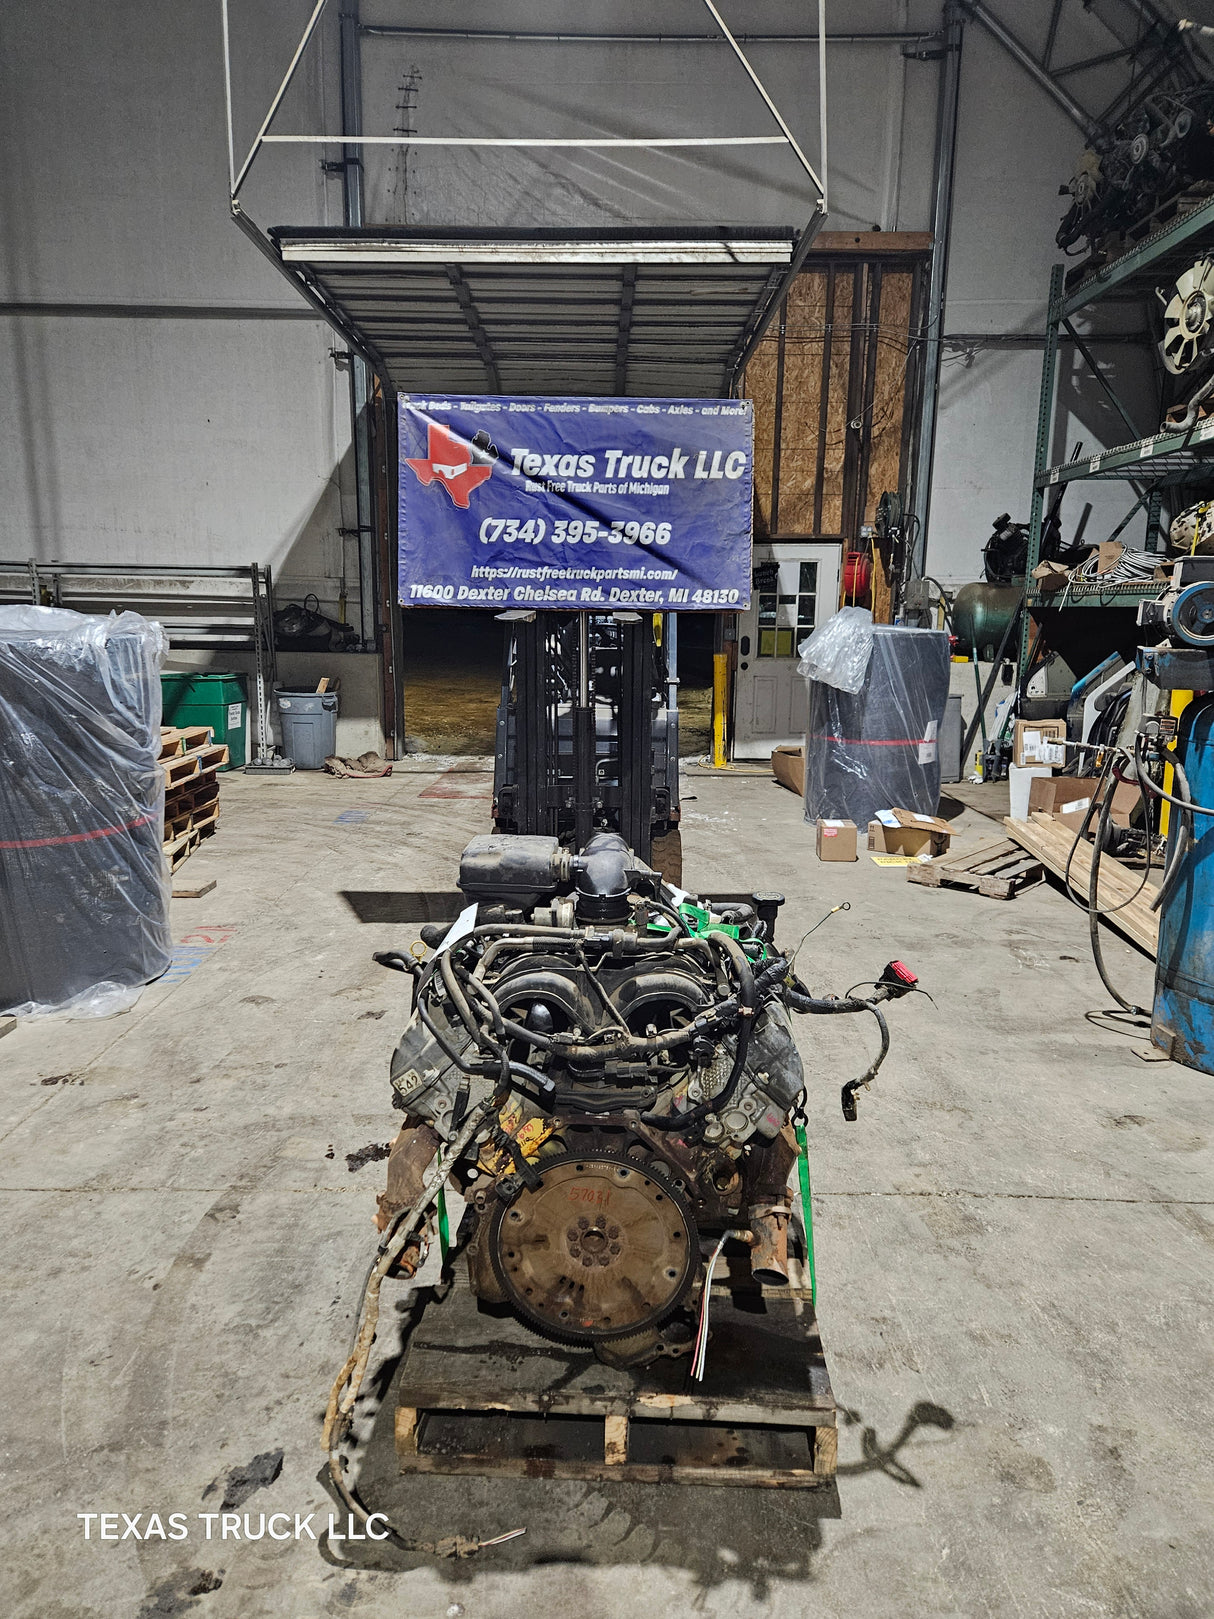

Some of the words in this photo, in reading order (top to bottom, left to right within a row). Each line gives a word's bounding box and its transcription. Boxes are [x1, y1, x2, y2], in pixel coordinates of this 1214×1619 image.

[460, 402, 501, 414] Tailgates
[509, 403, 536, 412] Doors
[543, 403, 581, 413] Fenders
[588, 404, 629, 414] Bumpers
[636, 404, 660, 414] Cabs
[667, 405, 694, 415] Axles
[701, 405, 719, 415] and
[510, 448, 596, 478] Texas
[604, 447, 691, 479] Truck
[693, 450, 748, 480] LLC
[546, 480, 566, 493] Free
[566, 480, 592, 493] Truck
[592, 481, 618, 495] Parts
[618, 481, 629, 495] of
[628, 481, 670, 497] Michigan
[478, 516, 547, 545] (734)
[550, 519, 673, 546] 395-3966
[470, 565, 679, 583] https://rustfreetruckpartsmi.com/
[409, 584, 455, 600] 11600
[456, 585, 511, 601] Dexter
[513, 585, 578, 601] Chelsea
[580, 586, 605, 602] Rd.
[608, 587, 664, 605] Dexter,
[667, 588, 690, 603] MI
[690, 588, 740, 604] 48130
